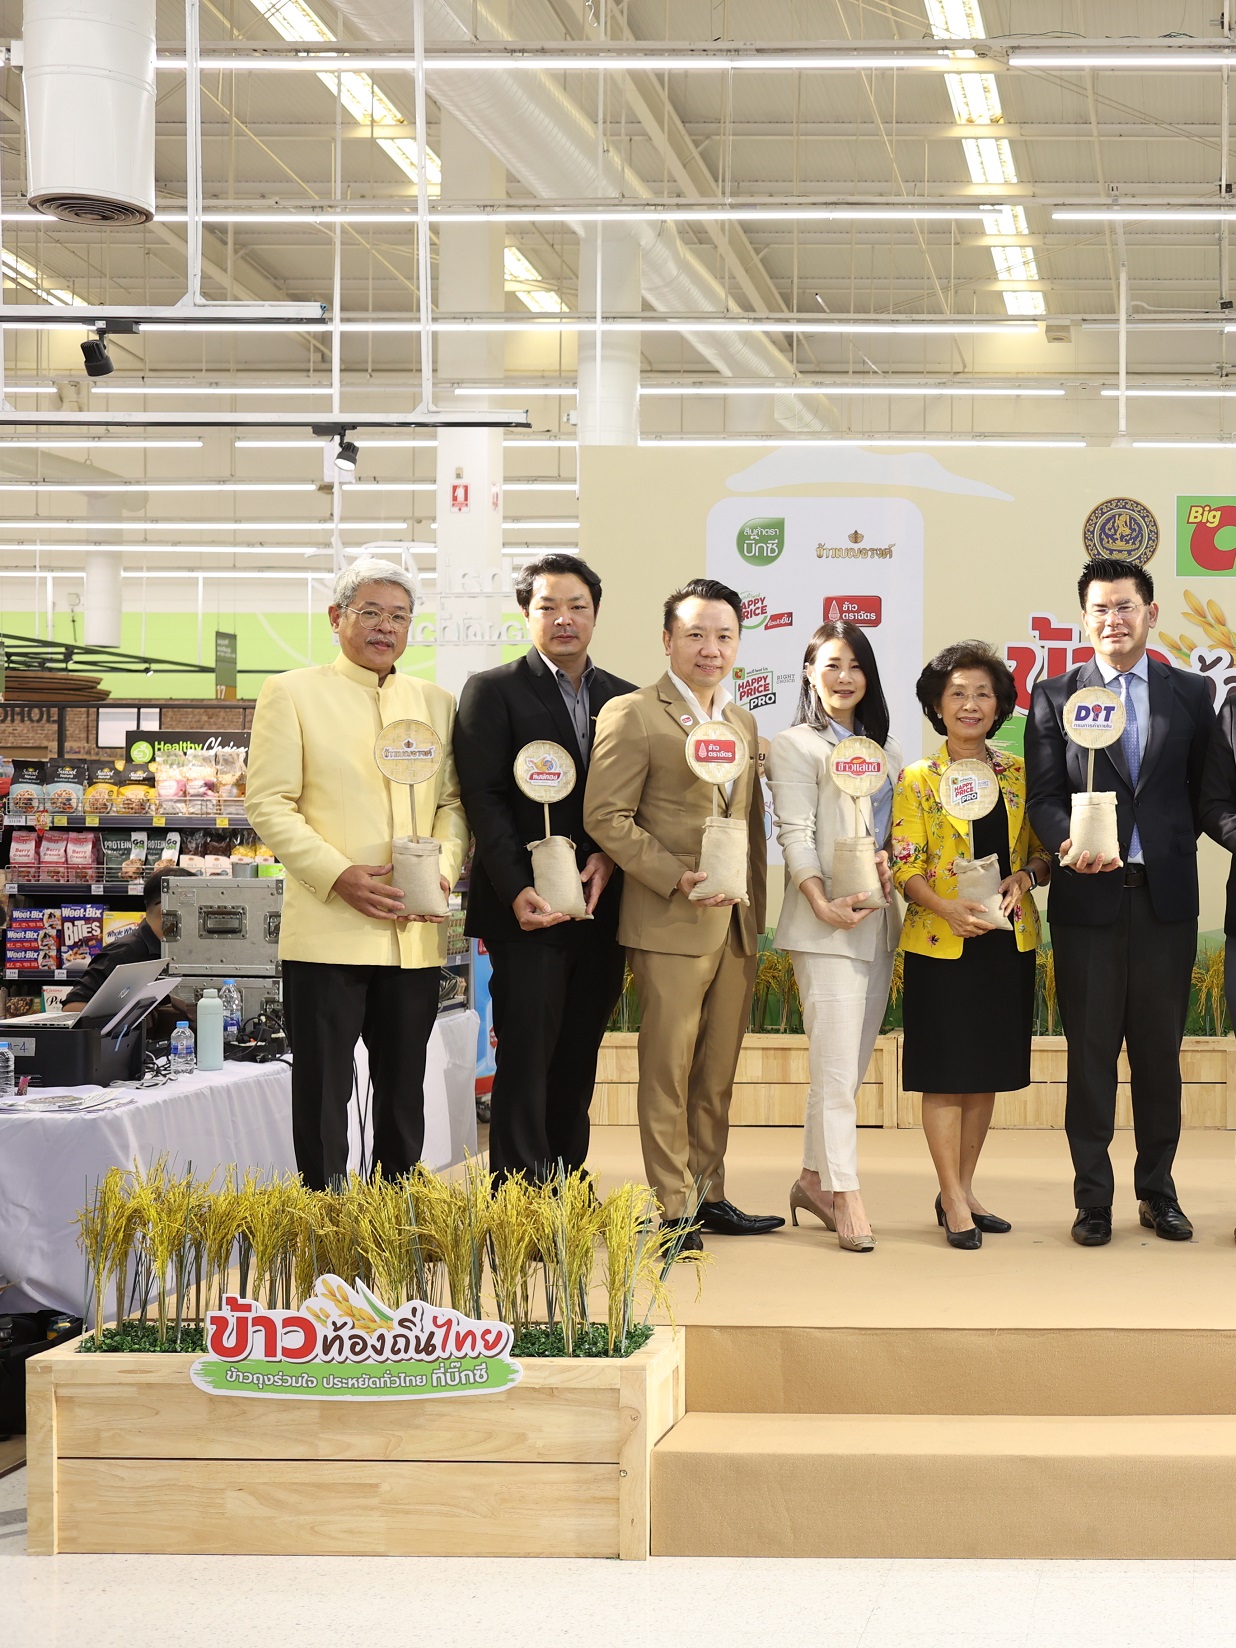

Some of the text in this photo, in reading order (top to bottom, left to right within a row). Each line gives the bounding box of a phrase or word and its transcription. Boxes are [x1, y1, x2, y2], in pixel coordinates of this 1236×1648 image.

[1188, 506, 1221, 527] Big
[815, 543, 896, 559] ข้าวเบญจรงค์
[741, 597, 766, 610] APPY
[843, 602, 858, 611] ข้าว
[741, 605, 767, 620] RICE
[843, 612, 876, 620] ตราฉัตร
[738, 675, 768, 691] HAPPY
[740, 683, 770, 701] PRICE
[751, 694, 775, 709] PRO
[1075, 705, 1115, 721] DIT
[154, 741, 203, 752] Healthy
[955, 782, 973, 791] HAPPY
[956, 787, 974, 798] PRICE
[962, 793, 977, 803] PRO
[104, 841, 132, 849] PROTEIN
[148, 841, 166, 849] ROTEIN
[12, 910, 43, 919] Weet-Bix
[61, 908, 102, 918] Weet-Bix
[7, 931, 38, 939] Weet-Bix
[6, 951, 38, 959] Weet-Bix
[210, 1297, 502, 1359] ข้าวท้องถิ่นไทย
[226, 1361, 489, 1389] ข้าวถุงร่วมใจ ประหยัดทั่วไทย ที่บิ๊กซี
